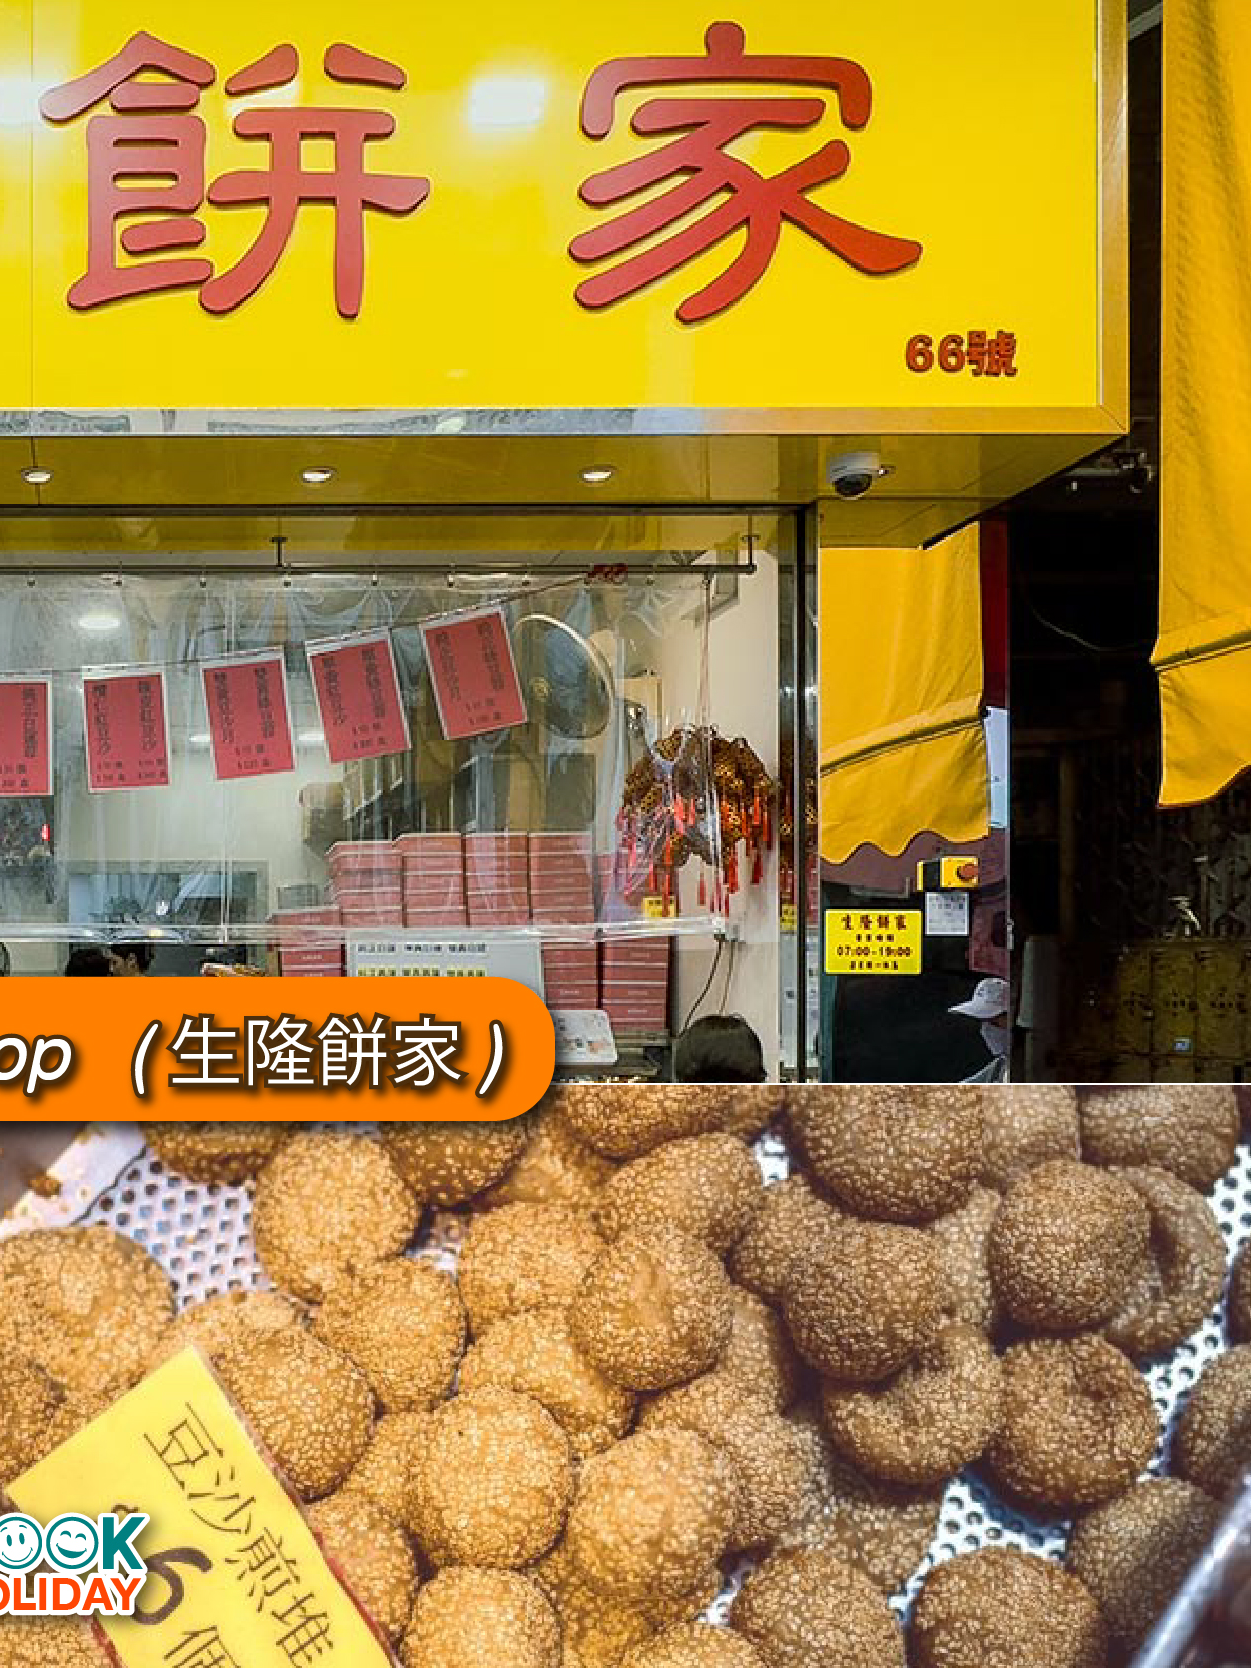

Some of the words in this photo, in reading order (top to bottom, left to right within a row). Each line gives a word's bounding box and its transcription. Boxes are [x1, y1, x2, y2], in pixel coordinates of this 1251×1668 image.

[905, 329, 1018, 377] 66號
[143, 1401, 333, 1668] 豆沙煎堆
